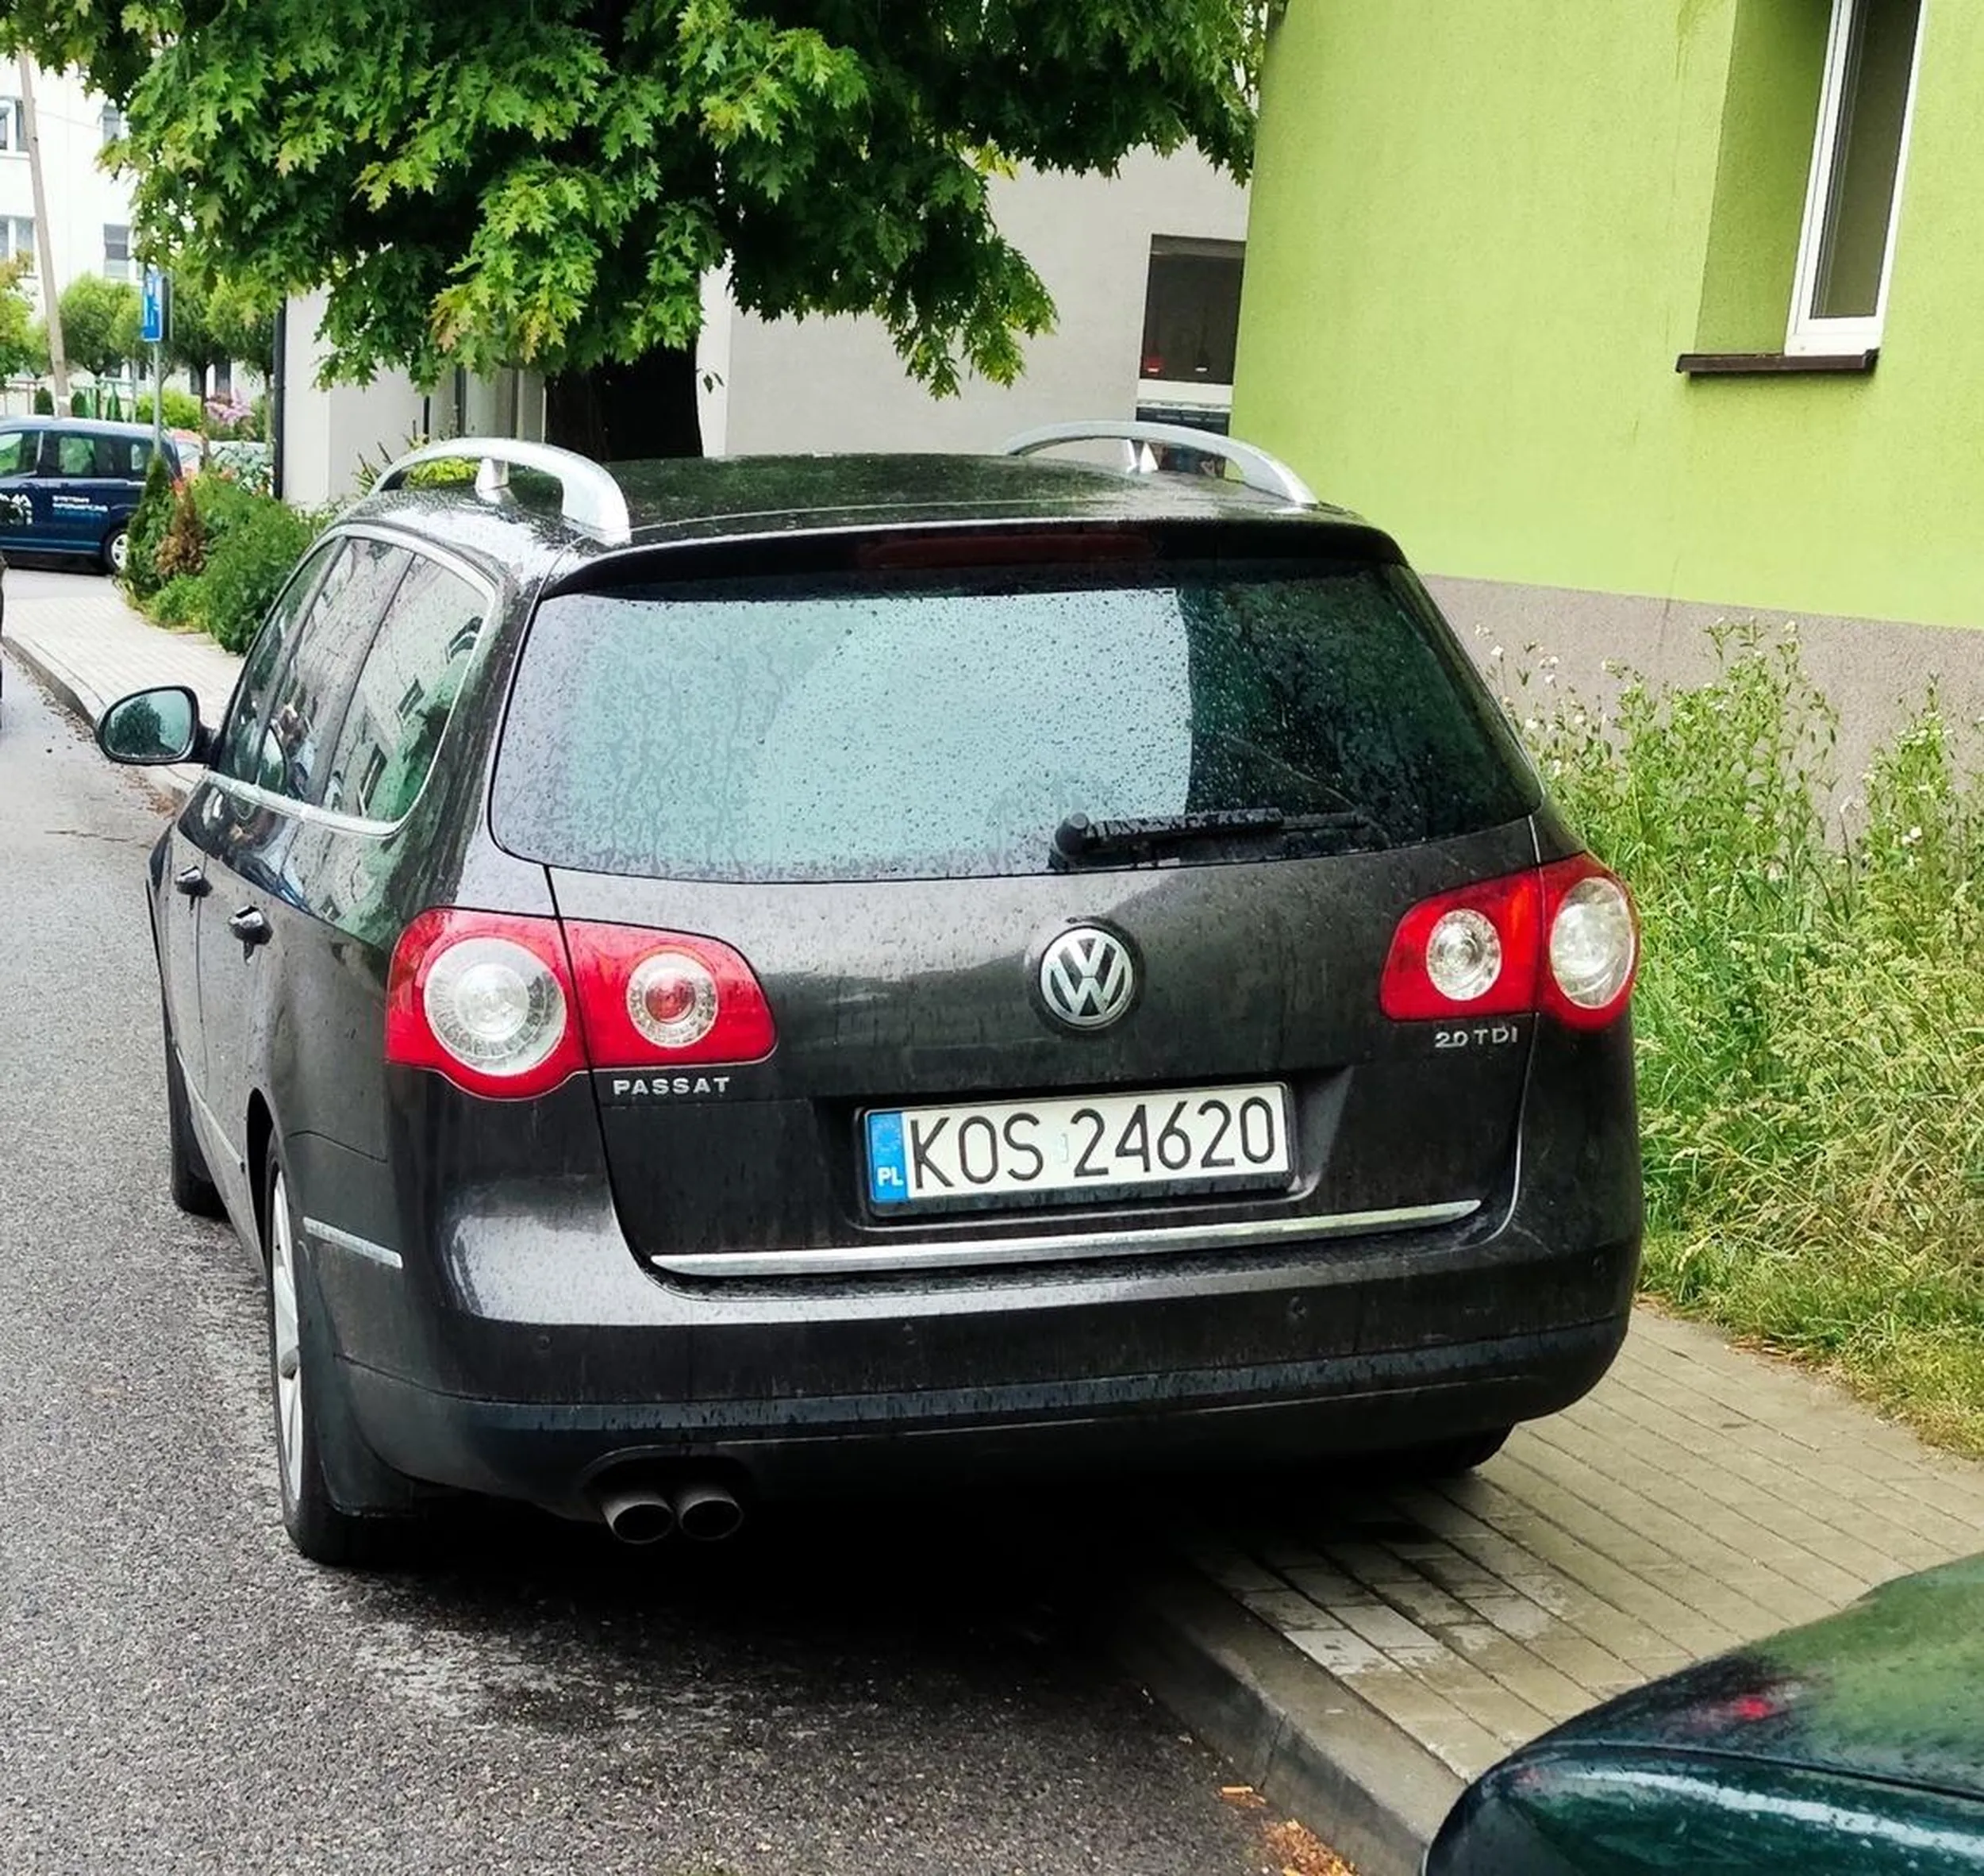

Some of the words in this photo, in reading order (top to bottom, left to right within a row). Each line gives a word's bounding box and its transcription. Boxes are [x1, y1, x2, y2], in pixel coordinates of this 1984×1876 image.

[1473, 1025, 1517, 1044] TDI
[613, 1076, 730, 1095] PASSAT
[877, 1166, 905, 1187] PL
[909, 1113, 1044, 1190] KOS
[1069, 1096, 1275, 1178] 24620
